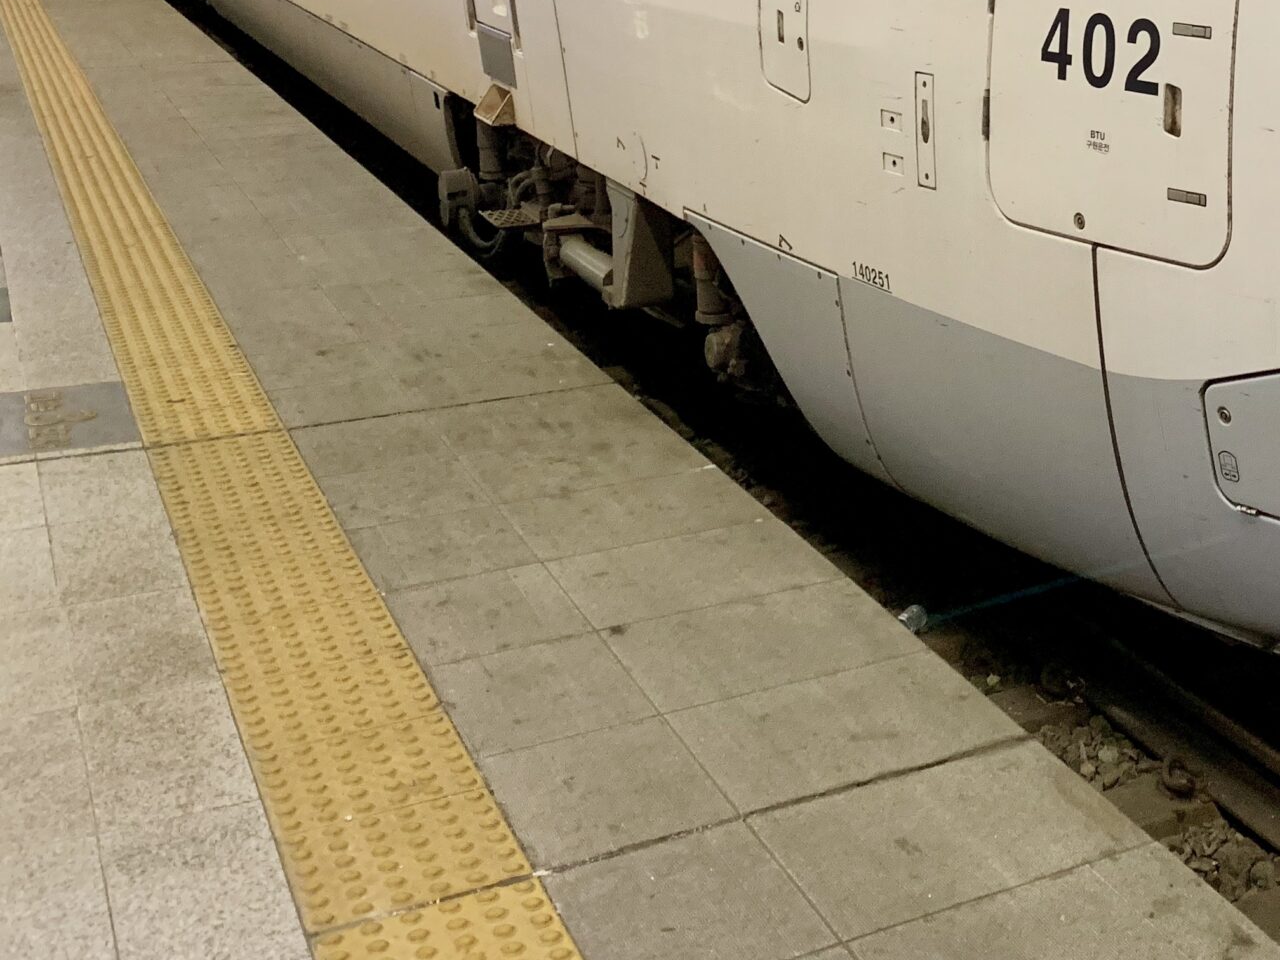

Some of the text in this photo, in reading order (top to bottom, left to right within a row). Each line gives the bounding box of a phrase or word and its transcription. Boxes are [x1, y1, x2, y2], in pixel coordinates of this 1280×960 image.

[1041, 7, 1161, 96] 402
[1090, 129, 1106, 141] BTU
[852, 261, 891, 290] 140251
